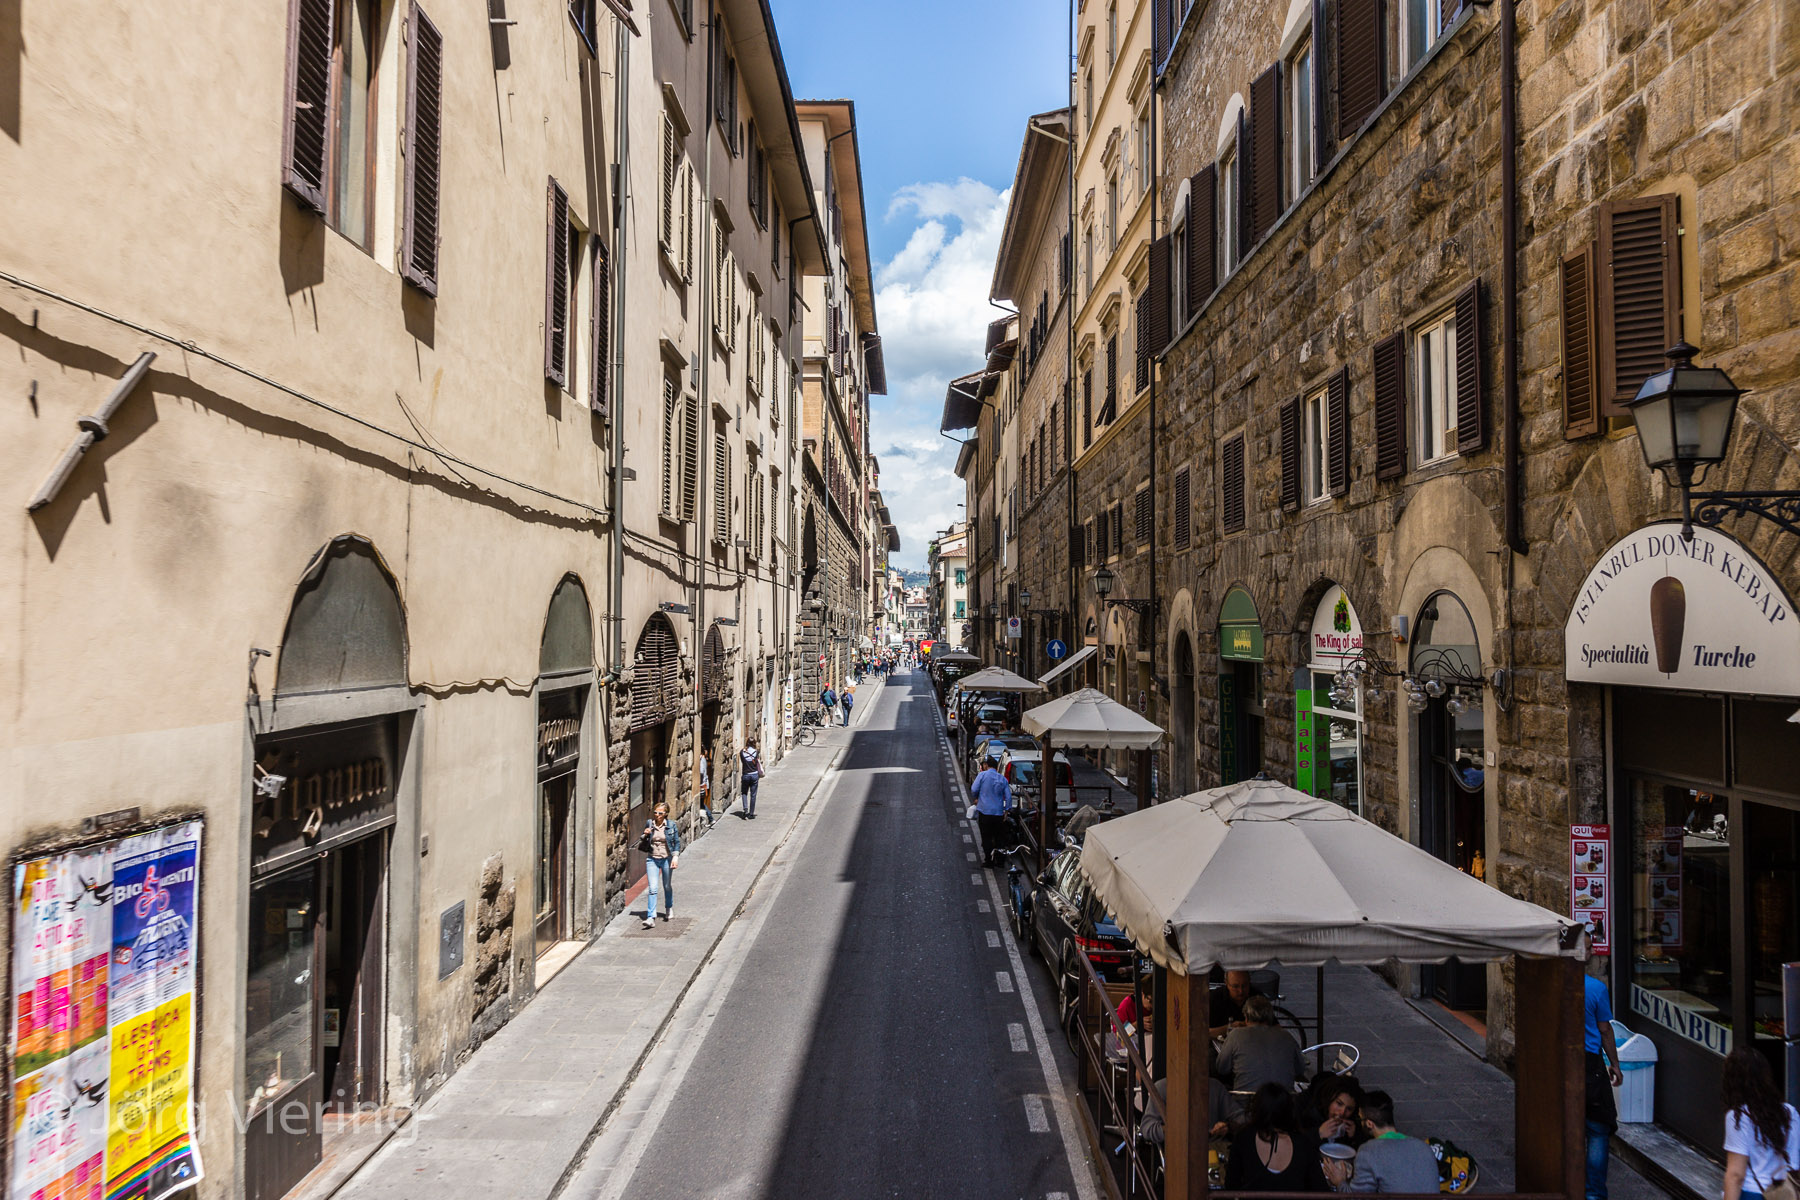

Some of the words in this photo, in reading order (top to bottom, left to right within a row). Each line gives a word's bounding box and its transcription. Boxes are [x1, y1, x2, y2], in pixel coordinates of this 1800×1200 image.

[1576, 543, 1644, 625] ISTANBUL
[1648, 534, 1715, 566] DONER
[1720, 551, 1786, 625] KEBAP
[1315, 634, 1326, 648] The
[1326, 634, 1341, 652] King
[1343, 634, 1349, 648] of
[1351, 634, 1363, 648] sal
[1581, 643, 1649, 668] Specialità
[1693, 645, 1756, 668] Turche
[1298, 710, 1310, 768] Take
